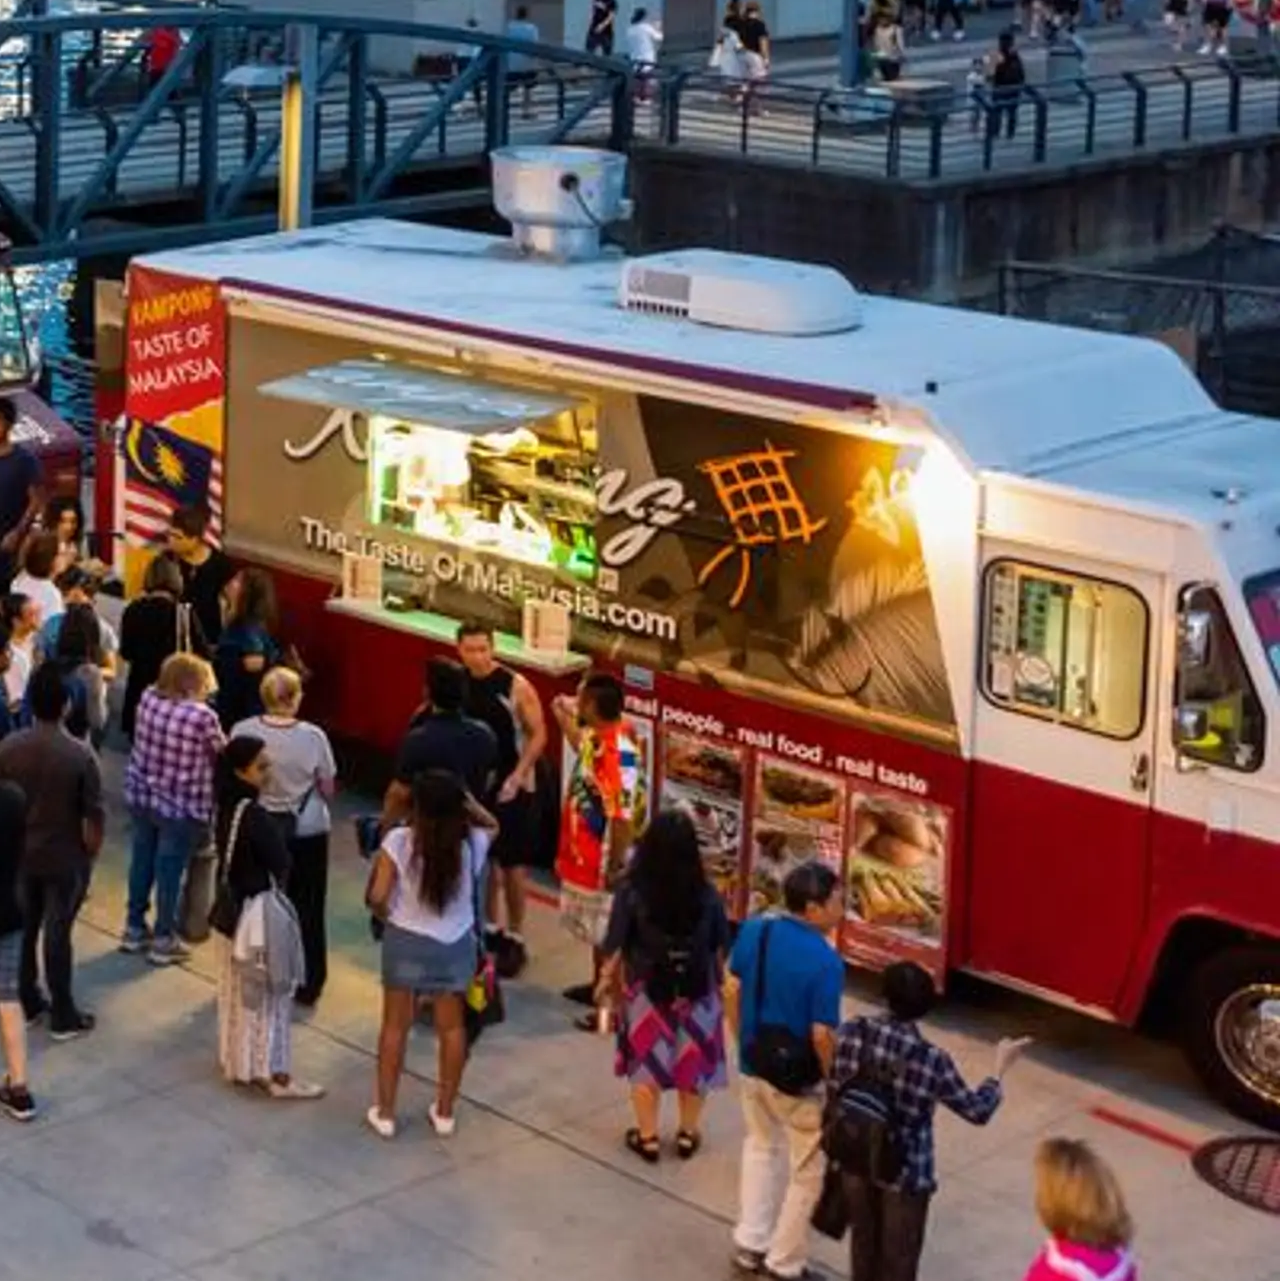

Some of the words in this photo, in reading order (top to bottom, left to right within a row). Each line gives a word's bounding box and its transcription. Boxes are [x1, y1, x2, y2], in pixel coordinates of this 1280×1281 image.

[132, 329, 181, 361] TASTE
[186, 322, 213, 349] OF
[129, 356, 222, 395] MALAYSIA
[300, 516, 348, 552] The
[358, 535, 425, 575] Taste
[431, 554, 470, 584] Of
[624, 694, 659, 717] real
[662, 704, 725, 736] people
[737, 727, 773, 751] real
[777, 734, 825, 764] food
[835, 754, 875, 780] real
[877, 765, 928, 796] taste
